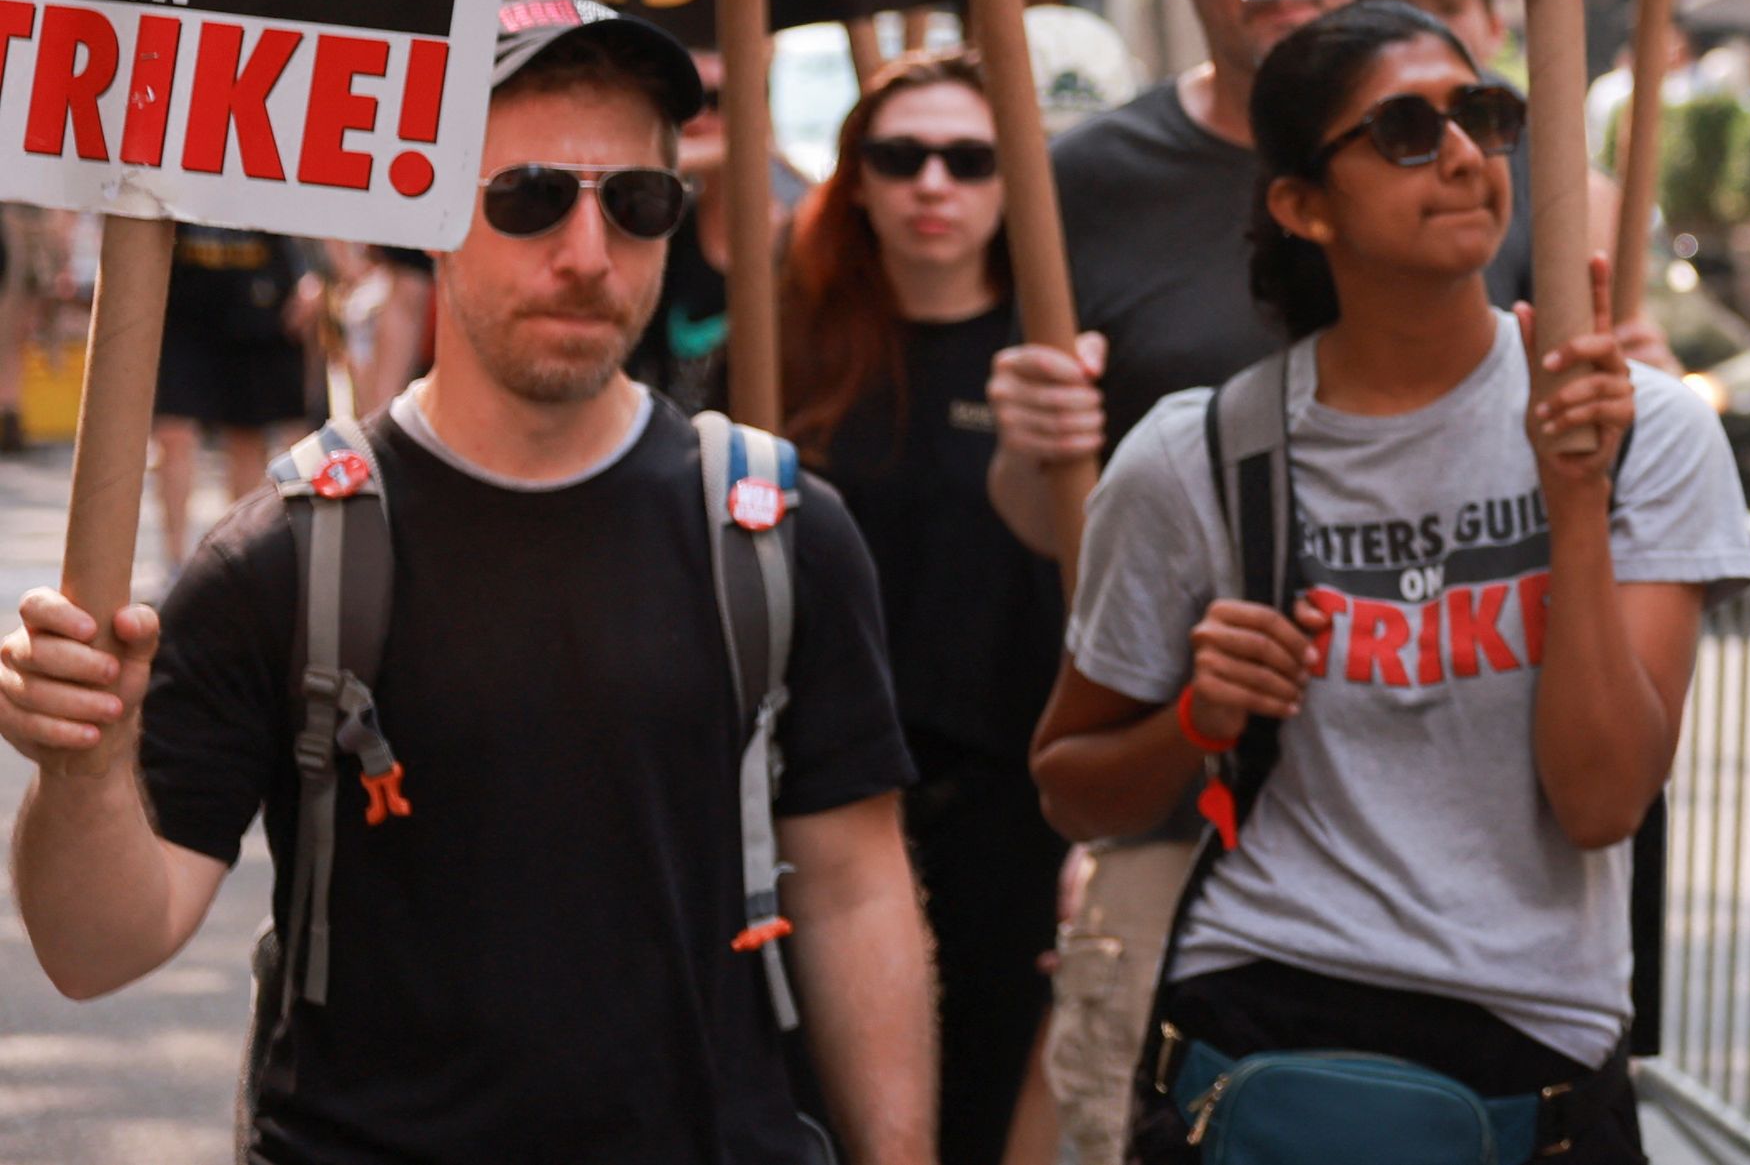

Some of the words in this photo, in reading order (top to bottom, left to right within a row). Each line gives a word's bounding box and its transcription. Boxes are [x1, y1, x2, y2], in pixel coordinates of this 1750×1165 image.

[1305, 514, 1444, 566] ITERS
[1455, 488, 1549, 543] GUIL
[1400, 565, 1444, 602] ON
